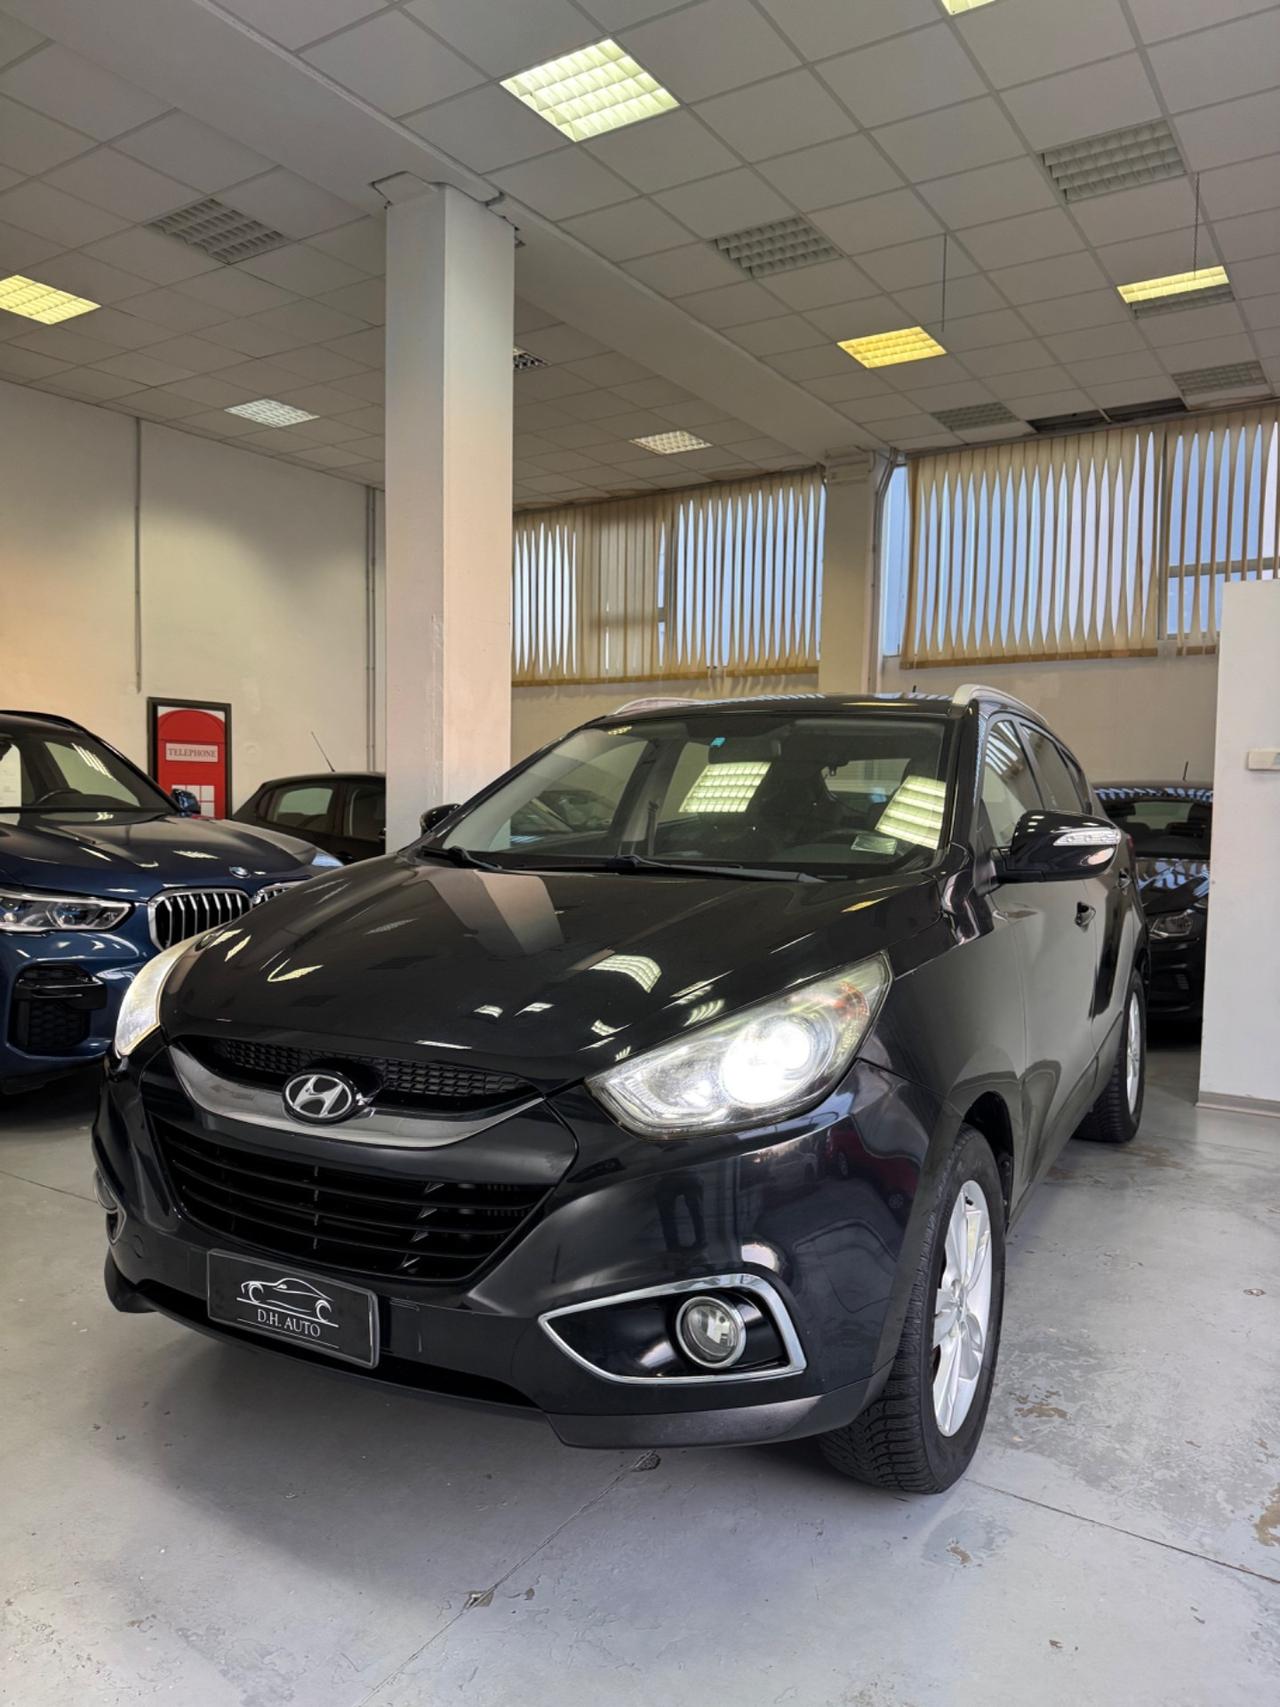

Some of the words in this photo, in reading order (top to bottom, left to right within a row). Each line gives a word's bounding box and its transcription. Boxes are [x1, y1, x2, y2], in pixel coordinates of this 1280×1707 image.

[168, 748, 216, 758] TELEPHONE
[257, 1309, 282, 1327] D.H.
[284, 1317, 321, 1337] AUTO
